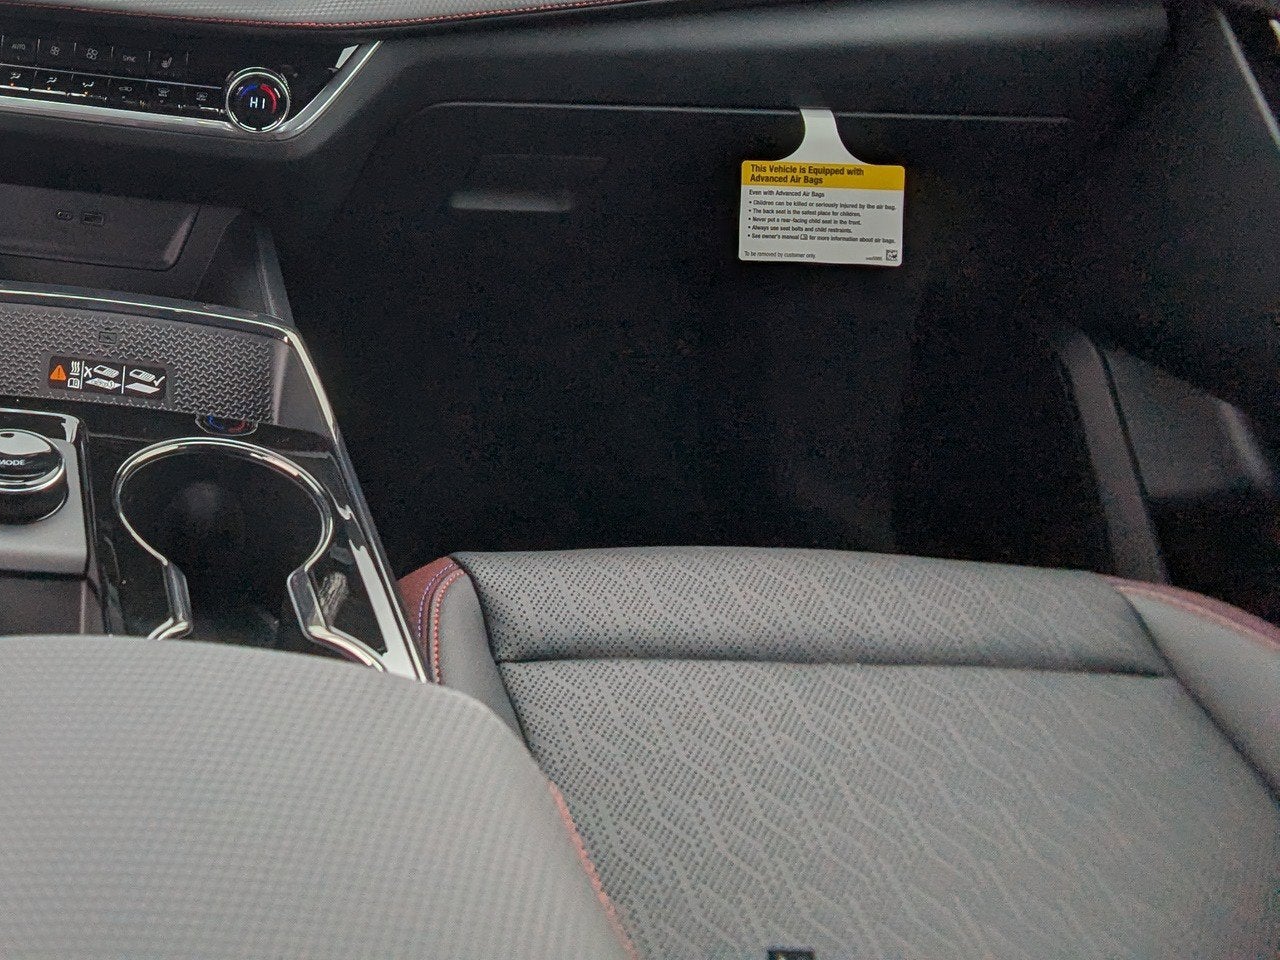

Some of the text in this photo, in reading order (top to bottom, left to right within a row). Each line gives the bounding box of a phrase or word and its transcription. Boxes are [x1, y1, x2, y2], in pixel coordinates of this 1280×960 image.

[11, 43, 26, 51] AUTO
[249, 96, 266, 110] HI
[751, 164, 864, 176] This Vehicle is Equipped with
[750, 174, 788, 182] Advanced
[804, 176, 823, 185] Bags
